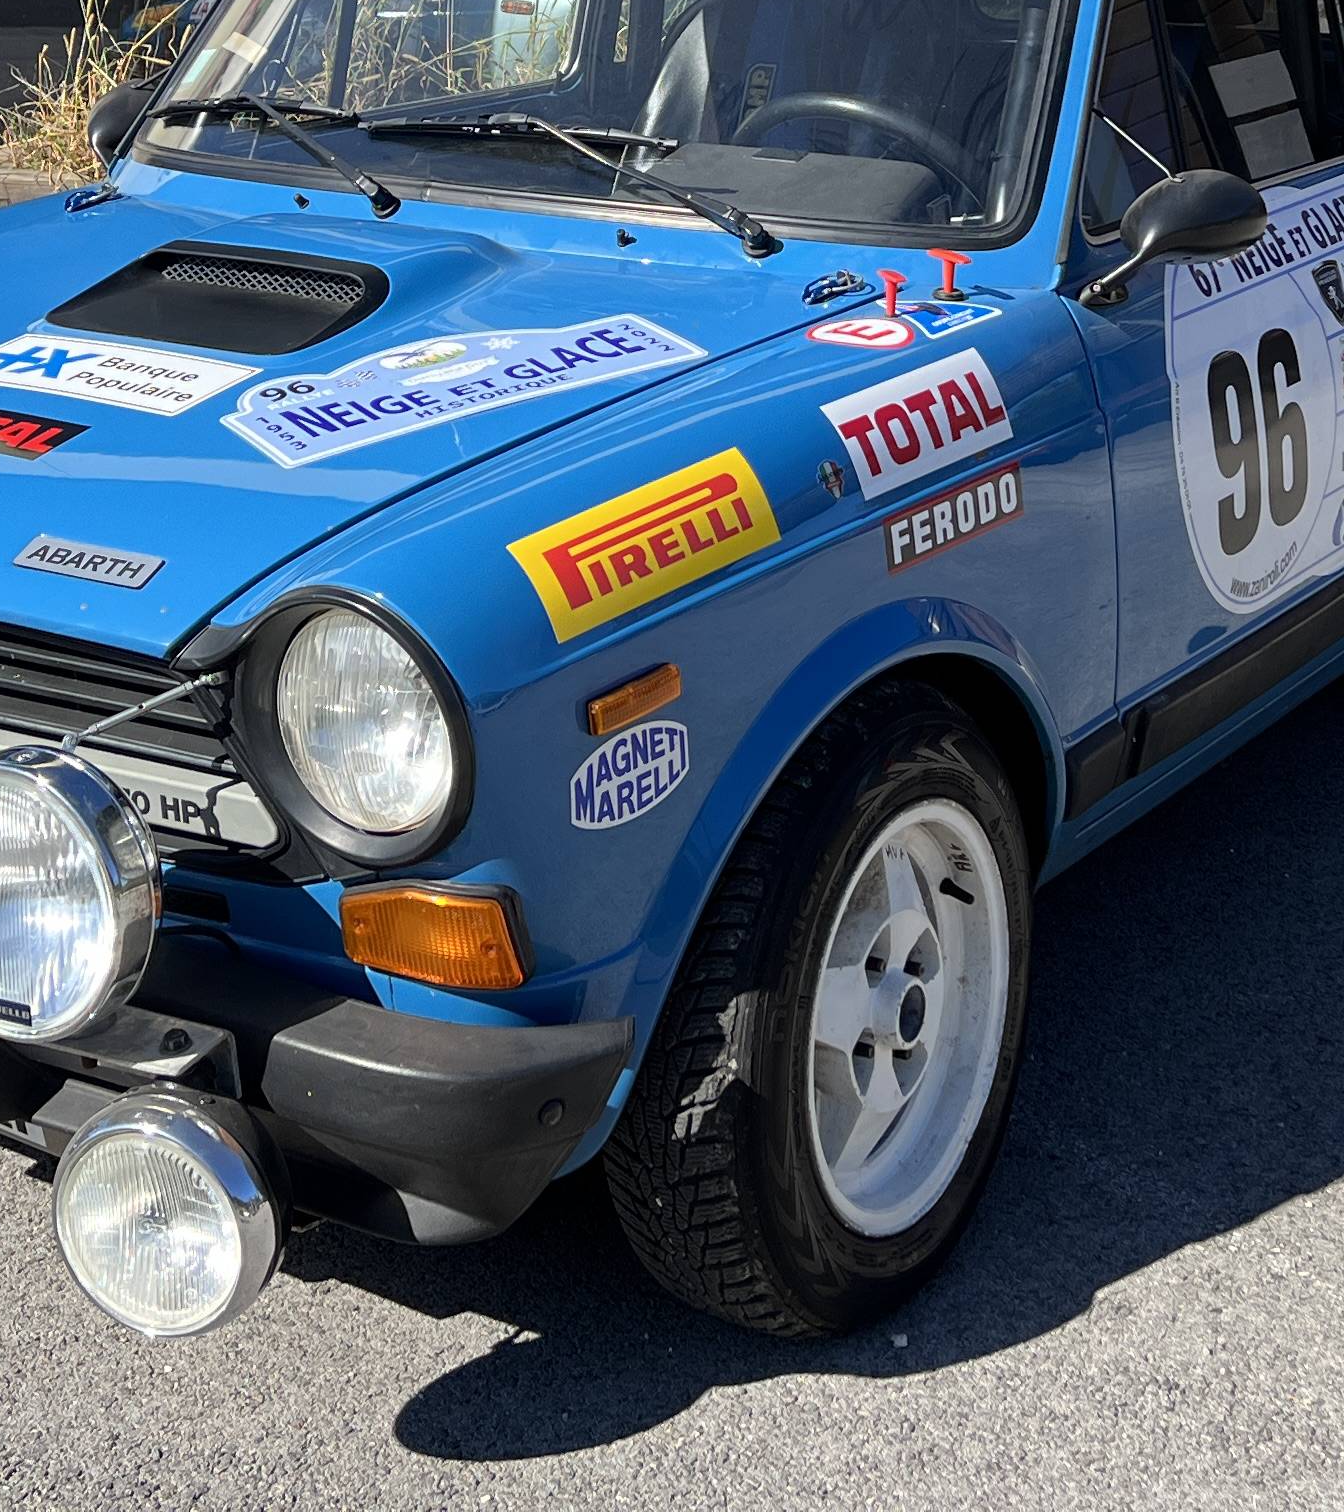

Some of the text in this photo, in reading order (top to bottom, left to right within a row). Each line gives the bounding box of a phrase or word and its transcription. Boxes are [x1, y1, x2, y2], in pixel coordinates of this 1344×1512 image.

[1231, 223, 1296, 284] NEIGE
[1287, 226, 1312, 259] ET
[617, 322, 675, 353] 2022
[69, 370, 193, 403] Populaire
[97, 356, 201, 382] Banque
[280, 388, 439, 438] NEIGE
[436, 376, 504, 399] ET
[503, 328, 647, 380] GLACE
[259, 379, 316, 403] 96
[416, 373, 574, 420] HISTORIQUE
[256, 417, 308, 451] 1953
[837, 370, 1008, 478] TOTAL
[1207, 327, 1309, 556] 96
[889, 470, 1020, 565] FERODO
[27, 543, 147, 581] ABARTH
[541, 471, 754, 611] PIRELLI
[161, 795, 201, 825] HP
